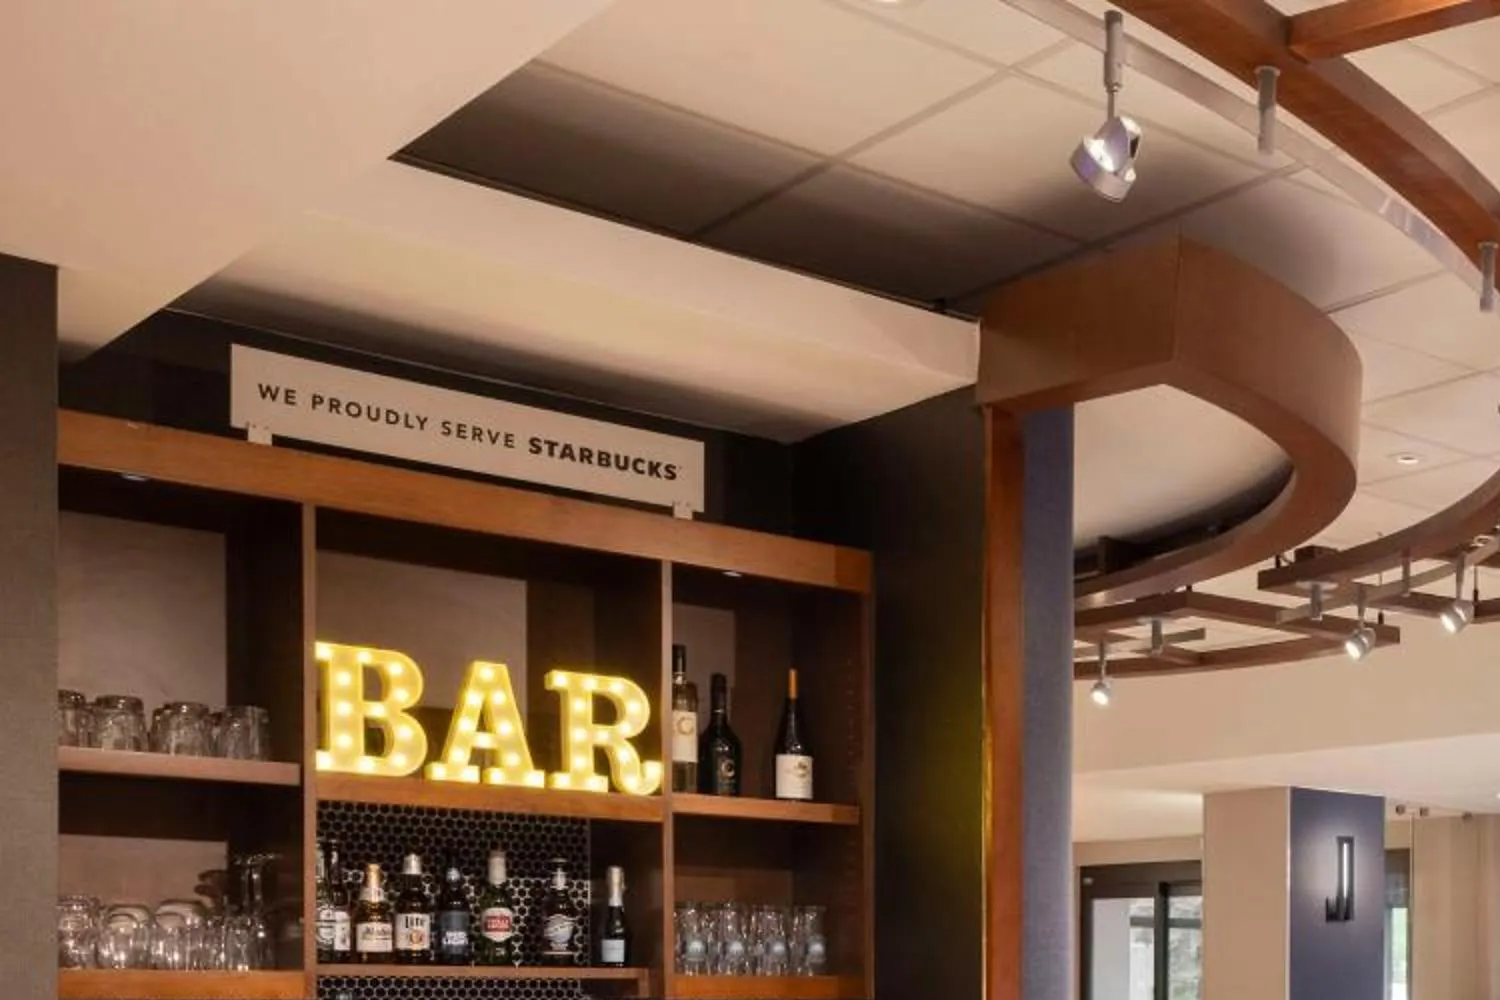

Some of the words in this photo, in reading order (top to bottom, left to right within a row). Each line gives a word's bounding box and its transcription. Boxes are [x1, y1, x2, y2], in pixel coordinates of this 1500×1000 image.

[258, 385, 297, 406] WE
[311, 393, 429, 431] PROUDLY
[441, 420, 516, 449] SERVE
[528, 436, 678, 481] STARBUCKS
[315, 641, 663, 796] BAR
